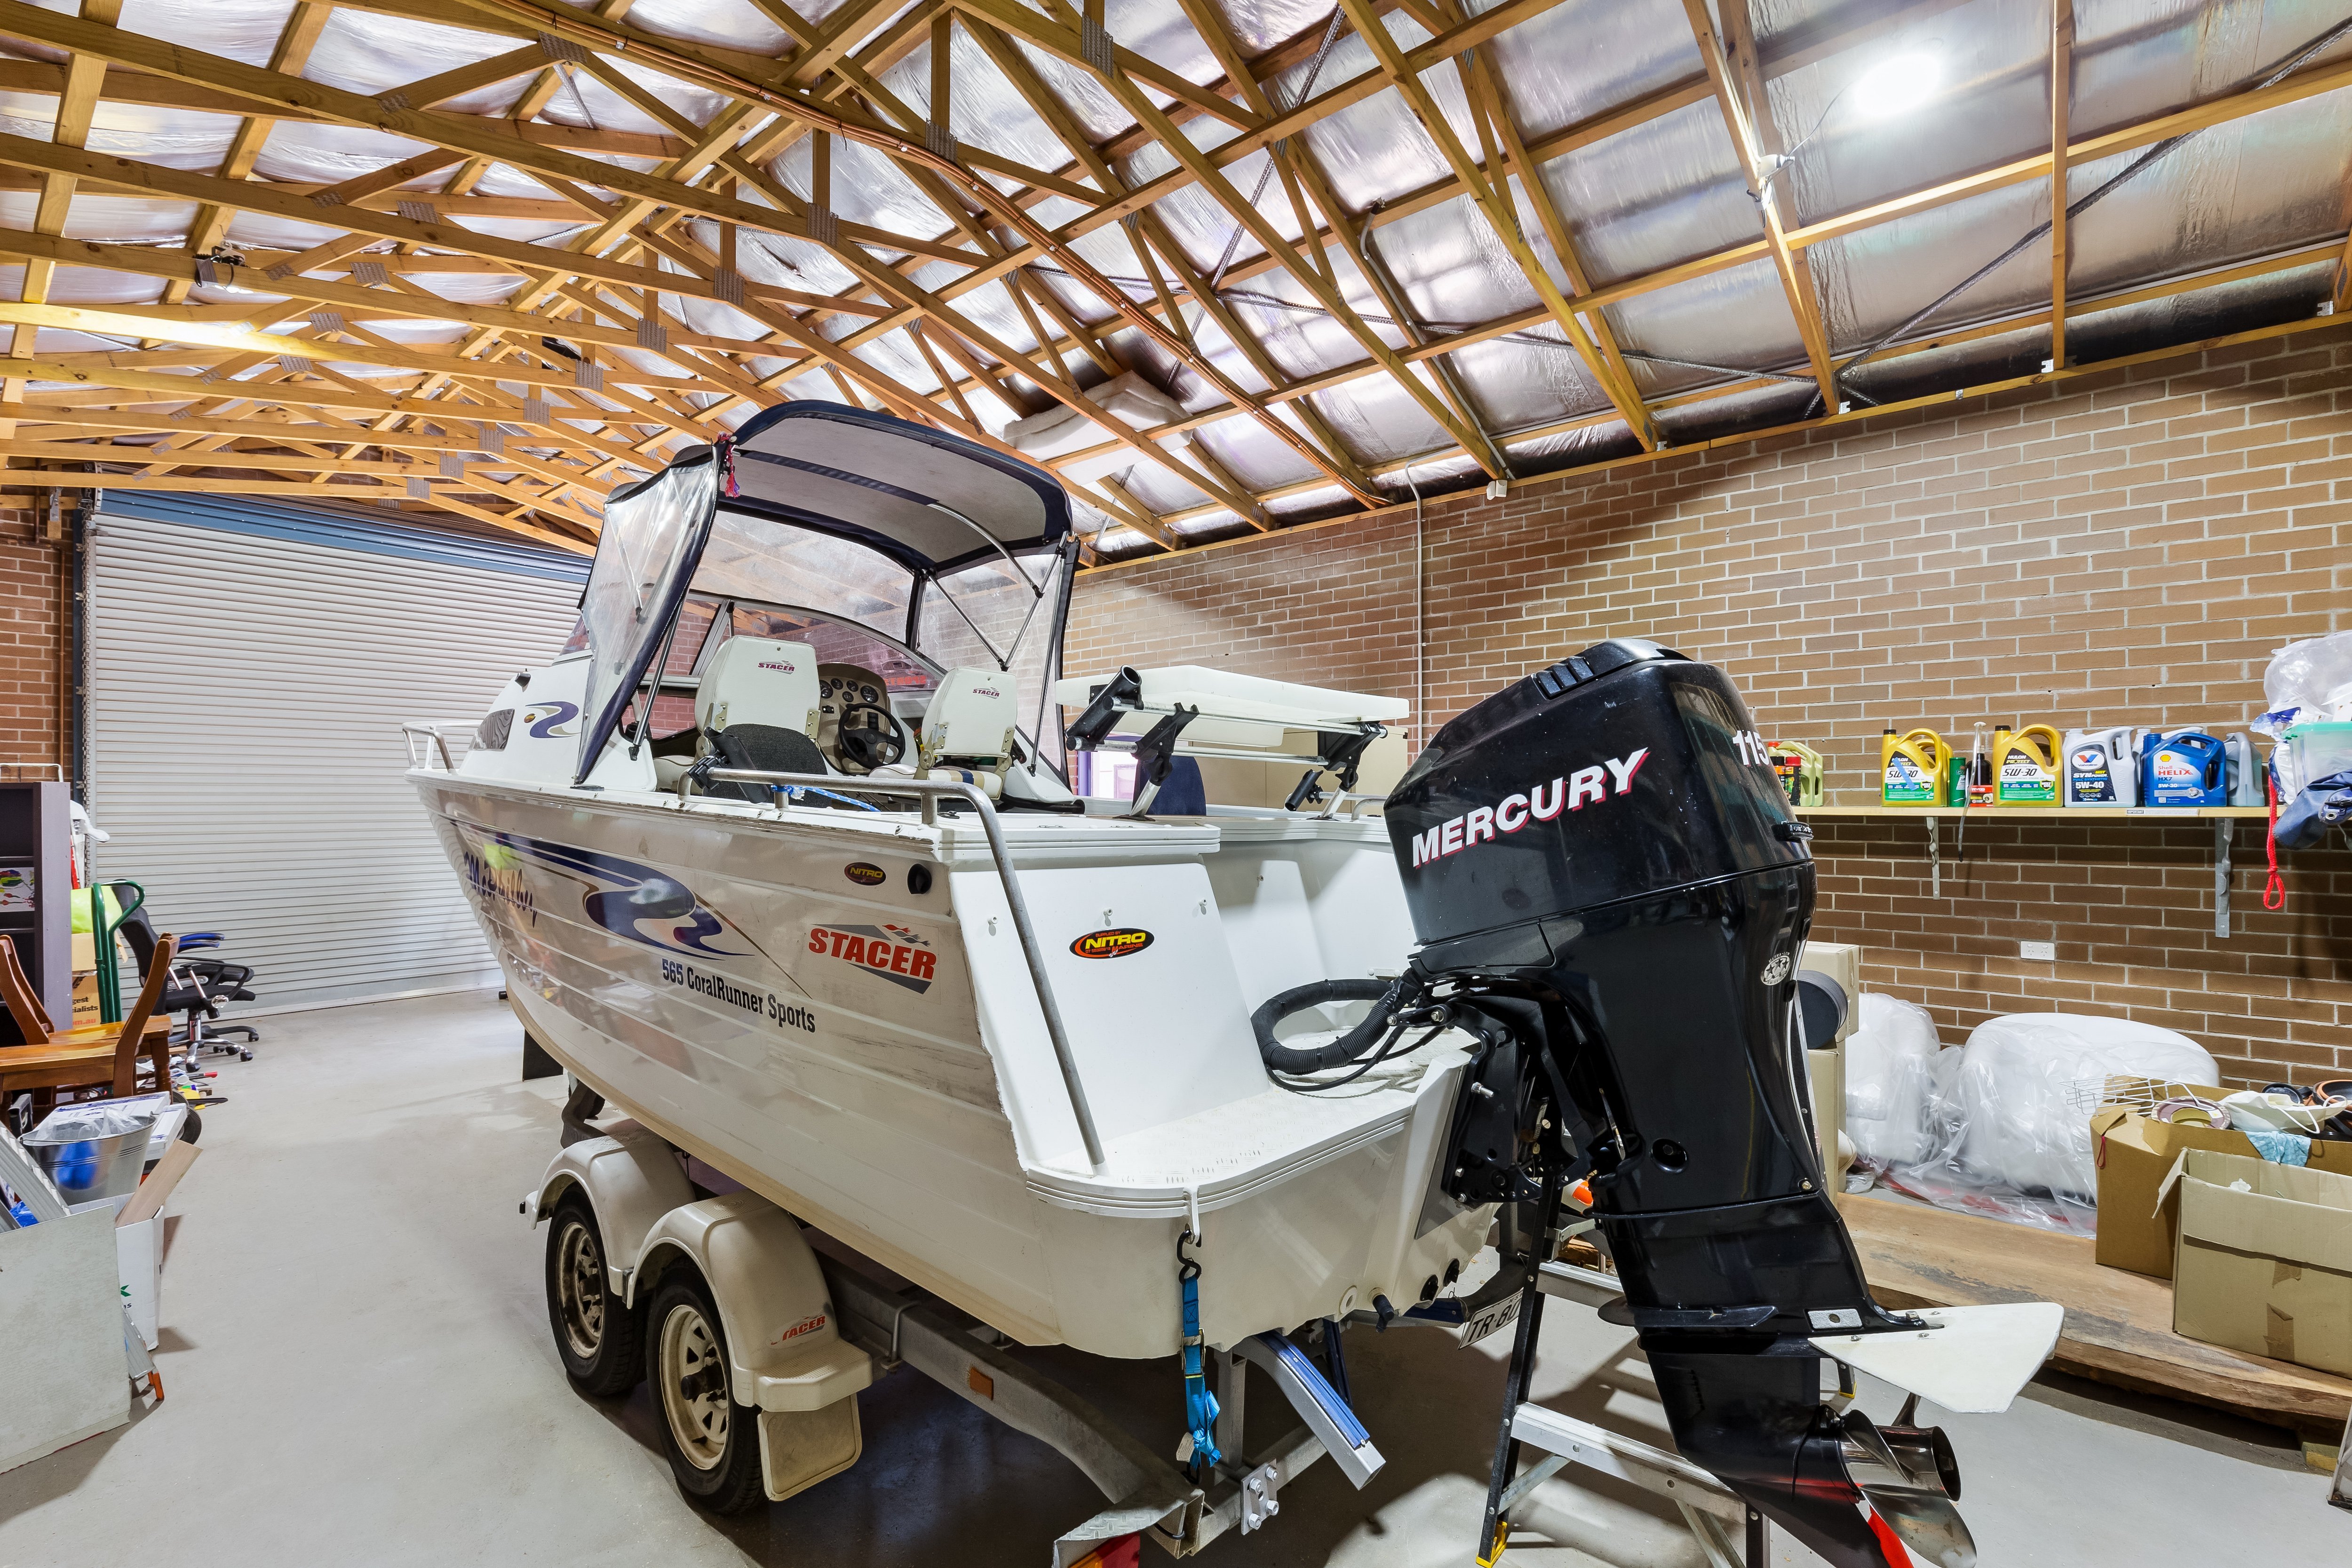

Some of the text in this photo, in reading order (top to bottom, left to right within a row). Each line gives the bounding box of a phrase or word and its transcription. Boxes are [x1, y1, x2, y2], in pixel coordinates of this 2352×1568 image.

[758, 662, 795, 671] STACER
[1732, 730, 1769, 765] 115
[1413, 747, 1650, 869] MERCURY
[850, 867, 883, 878] NITRO
[1085, 932, 1146, 949] NITRO
[1112, 943, 1144, 953] MARINE
[809, 928, 937, 980] STACER
[662, 958, 816, 1033] 565 CoralRunner Sports
